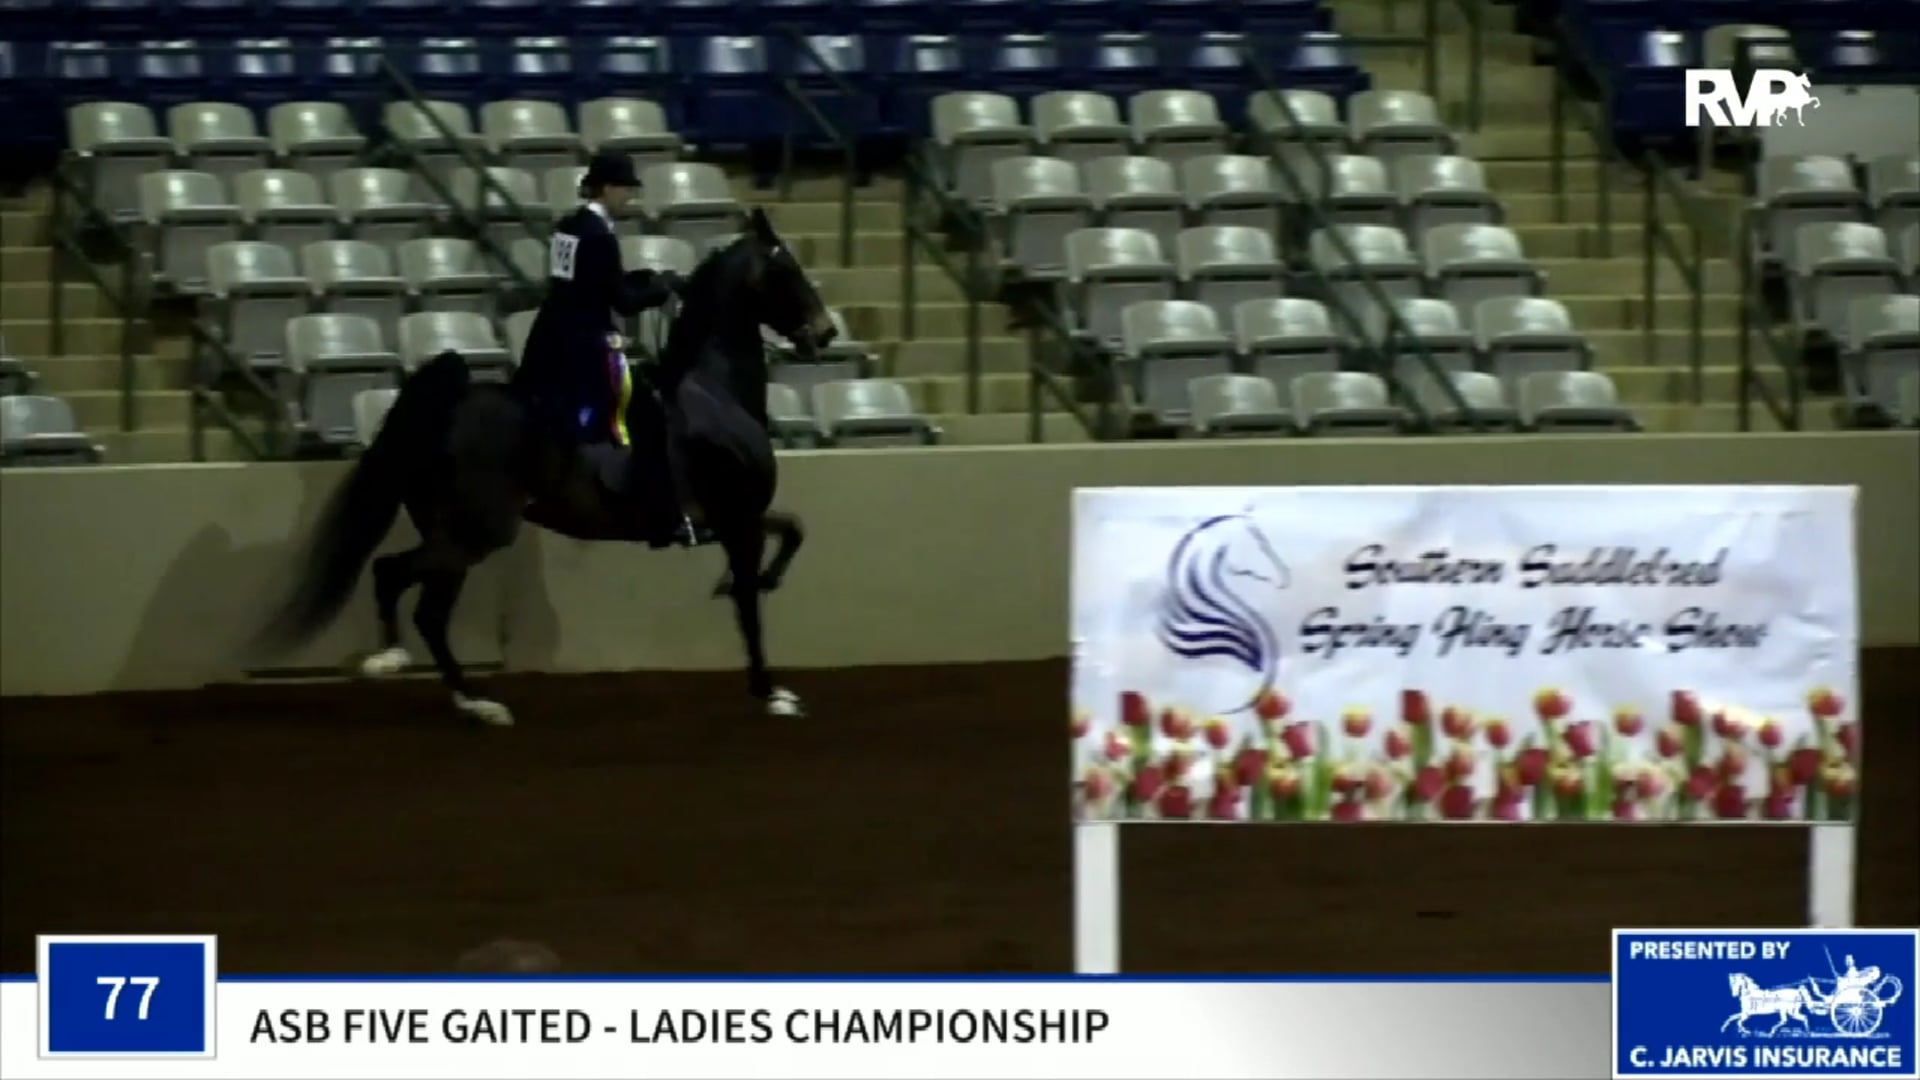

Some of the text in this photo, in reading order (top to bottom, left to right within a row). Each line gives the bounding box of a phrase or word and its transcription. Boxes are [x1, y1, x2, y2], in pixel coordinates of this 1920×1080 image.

[1344, 543, 1504, 589] Southern
[1299, 605, 1768, 659] Spring Fling Horse Show
